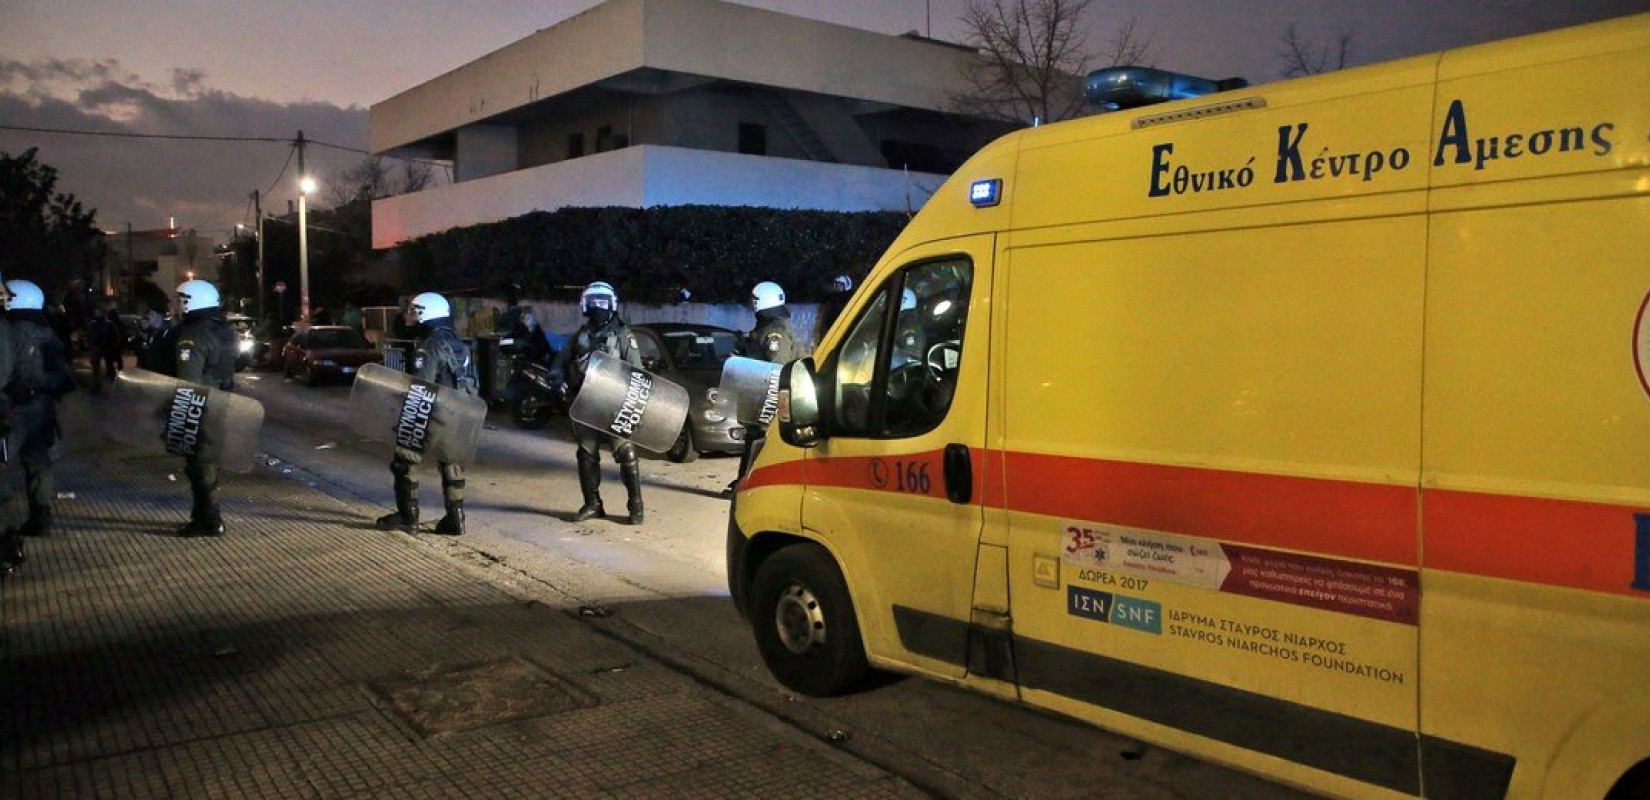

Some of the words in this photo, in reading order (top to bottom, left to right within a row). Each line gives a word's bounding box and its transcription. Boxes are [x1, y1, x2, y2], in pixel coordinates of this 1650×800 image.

[1148, 142, 1255, 197] Εθνικό
[1274, 122, 1410, 184] Κέντρο
[1433, 99, 1614, 170] Αμεσης
[167, 388, 194, 453] ΑΣΤΥΝΟΜΙΑ
[182, 394, 206, 455] POLICE
[398, 384, 426, 447] ΑΣΤΥΝΟΜΙΑ
[410, 390, 437, 449] POLICE
[609, 371, 645, 433] ΑΣΤΥΝΟΜΙΑ
[622, 379, 652, 434] POLICE
[895, 460, 930, 493] 166
[1074, 594, 1104, 614] ΙΣΝ
[1079, 569, 1116, 585] ΔΩΡΕΑ
[1120, 576, 1148, 592] 2017
[1117, 603, 1155, 624] SNF
[1169, 609, 1216, 627] ΙΔΡΥΜΑ
[1219, 619, 1279, 641] ΣΤΑΥΡΟΣ
[1284, 633, 1347, 655] ΝΙΑΡΧΟΣ
[1169, 624, 1223, 645] STAVROS
[1227, 638, 1298, 662] NIARCHOS
[1302, 652, 1404, 684] FOUNDATION
